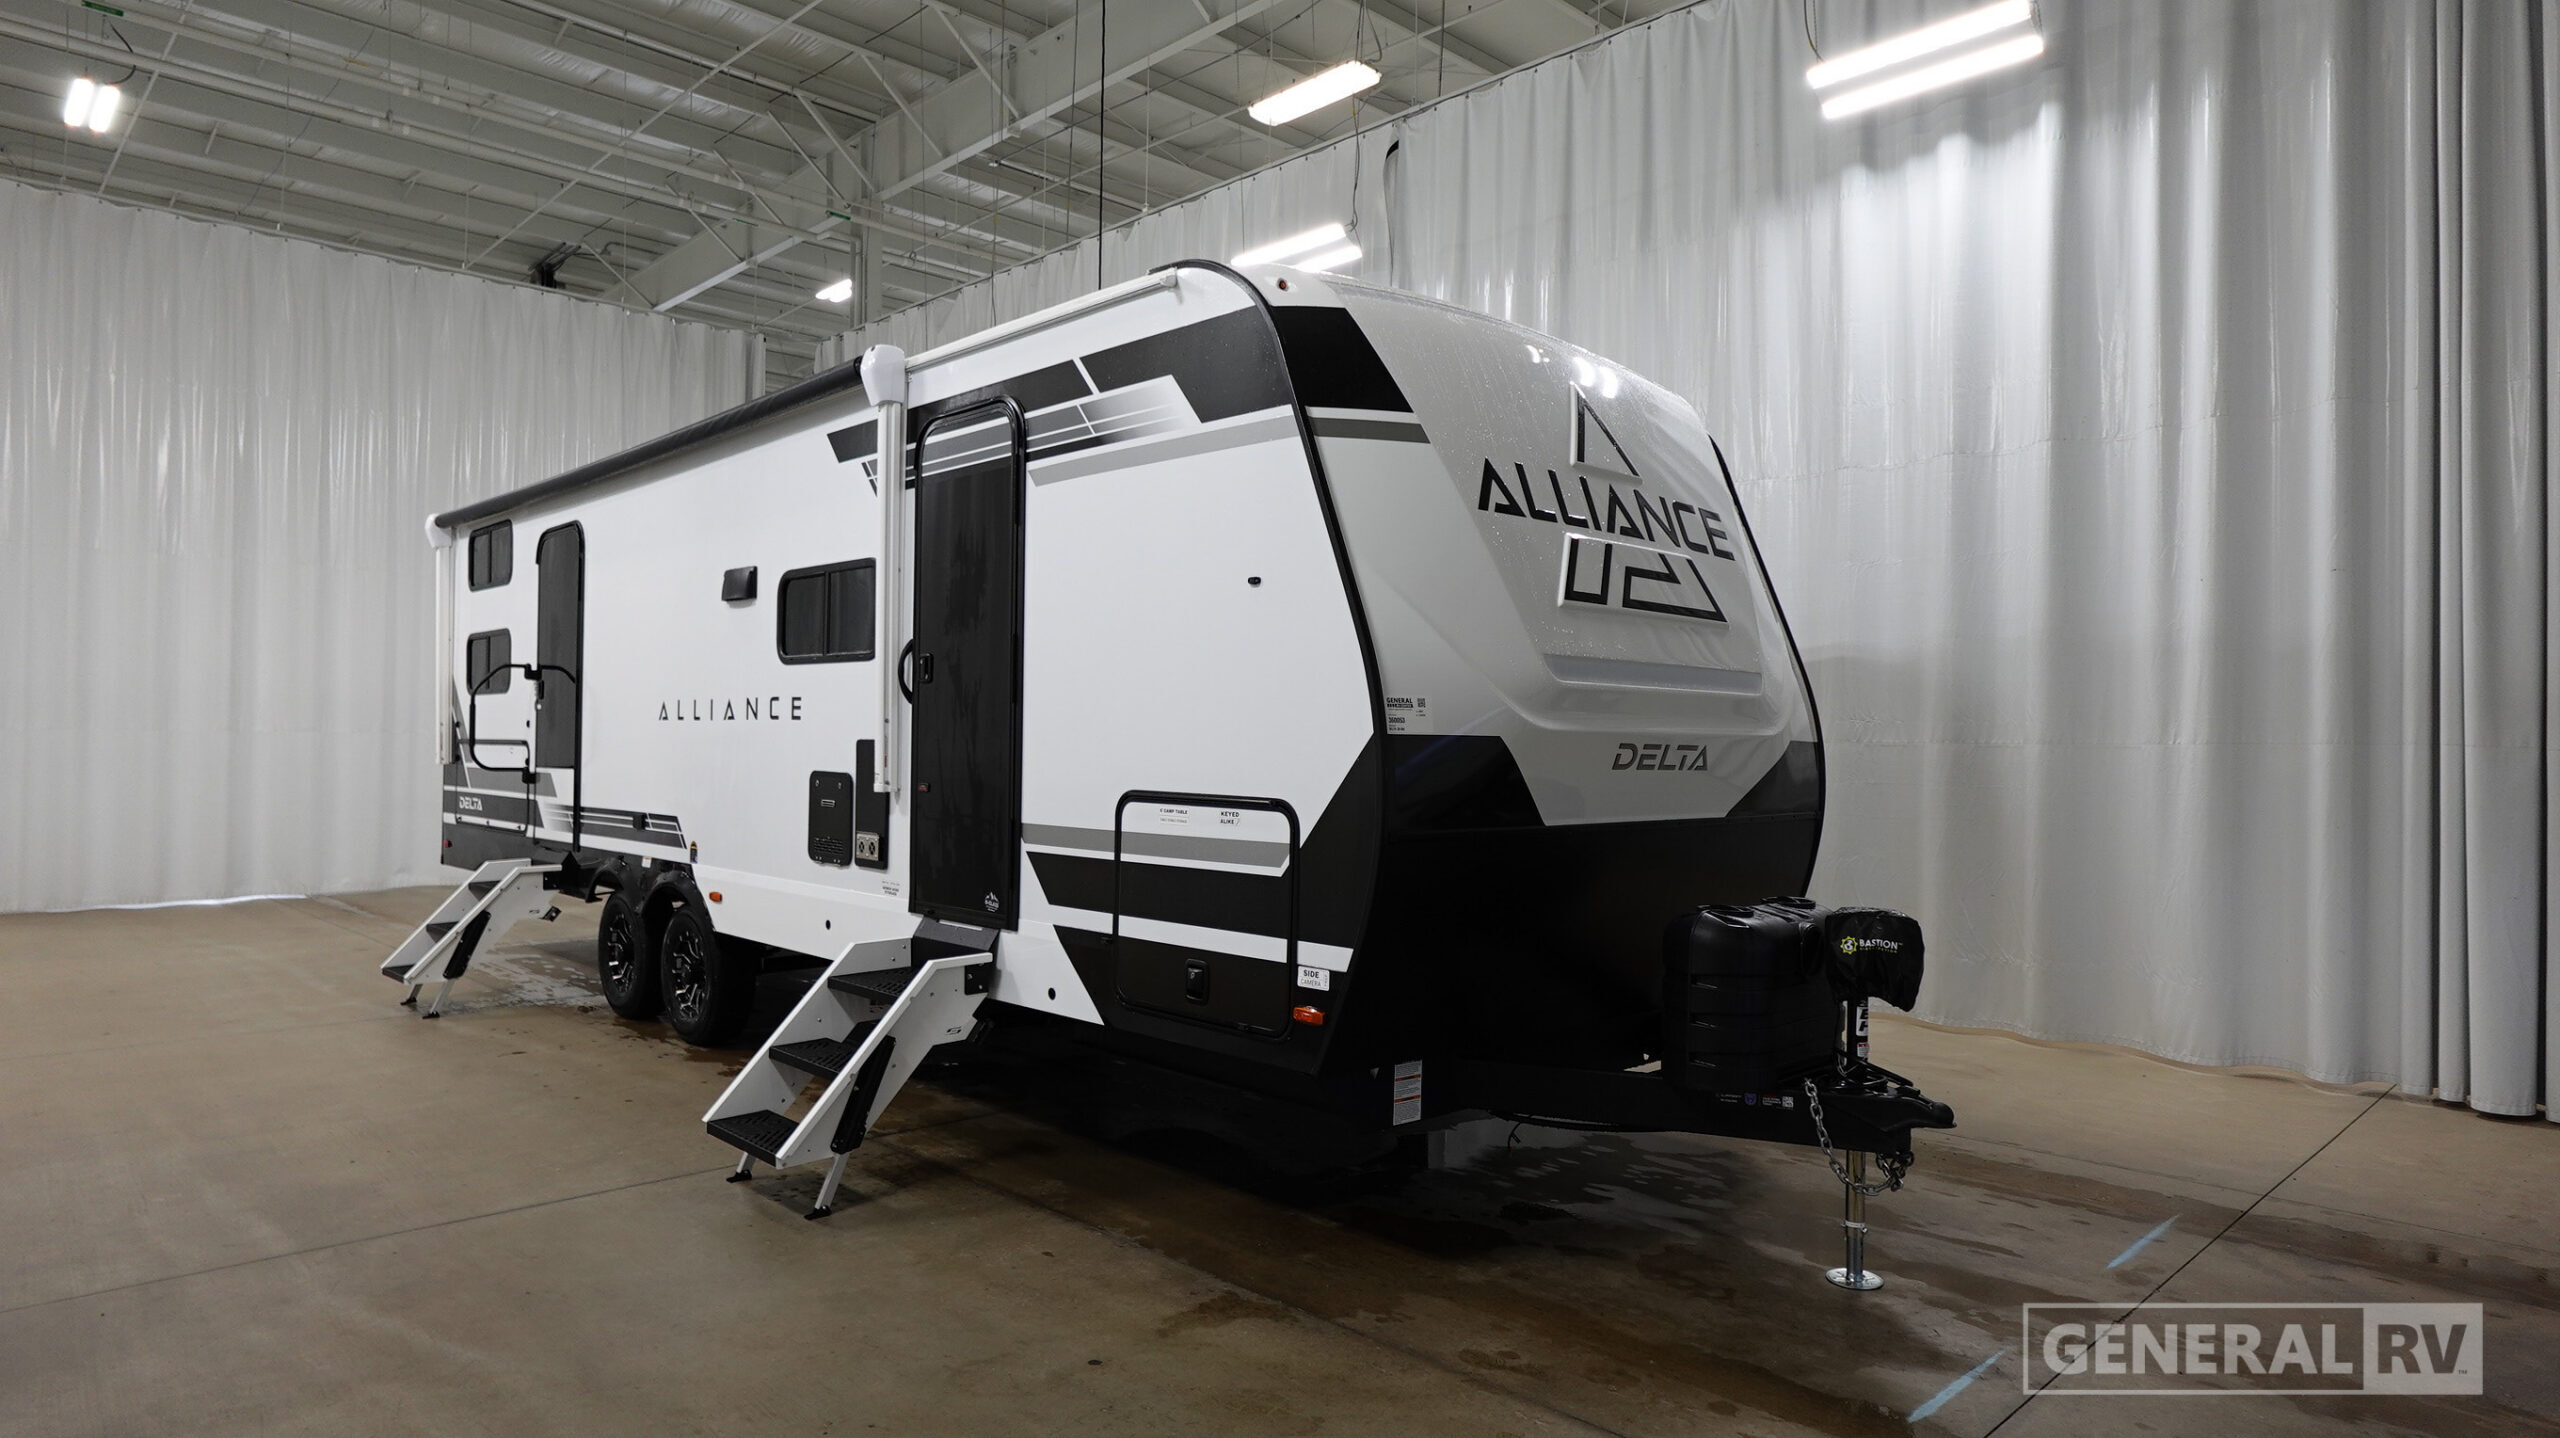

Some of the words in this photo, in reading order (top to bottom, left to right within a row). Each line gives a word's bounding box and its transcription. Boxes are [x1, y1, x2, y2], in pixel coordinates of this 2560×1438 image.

[1478, 457, 1735, 561] ALLIANCE
[659, 696, 802, 720] ALLIANCE
[1612, 743, 1708, 771] DELTA
[459, 796, 482, 811] DELTA
[1859, 939, 1898, 950] BASTION
[1303, 970, 1320, 979] SIDE
